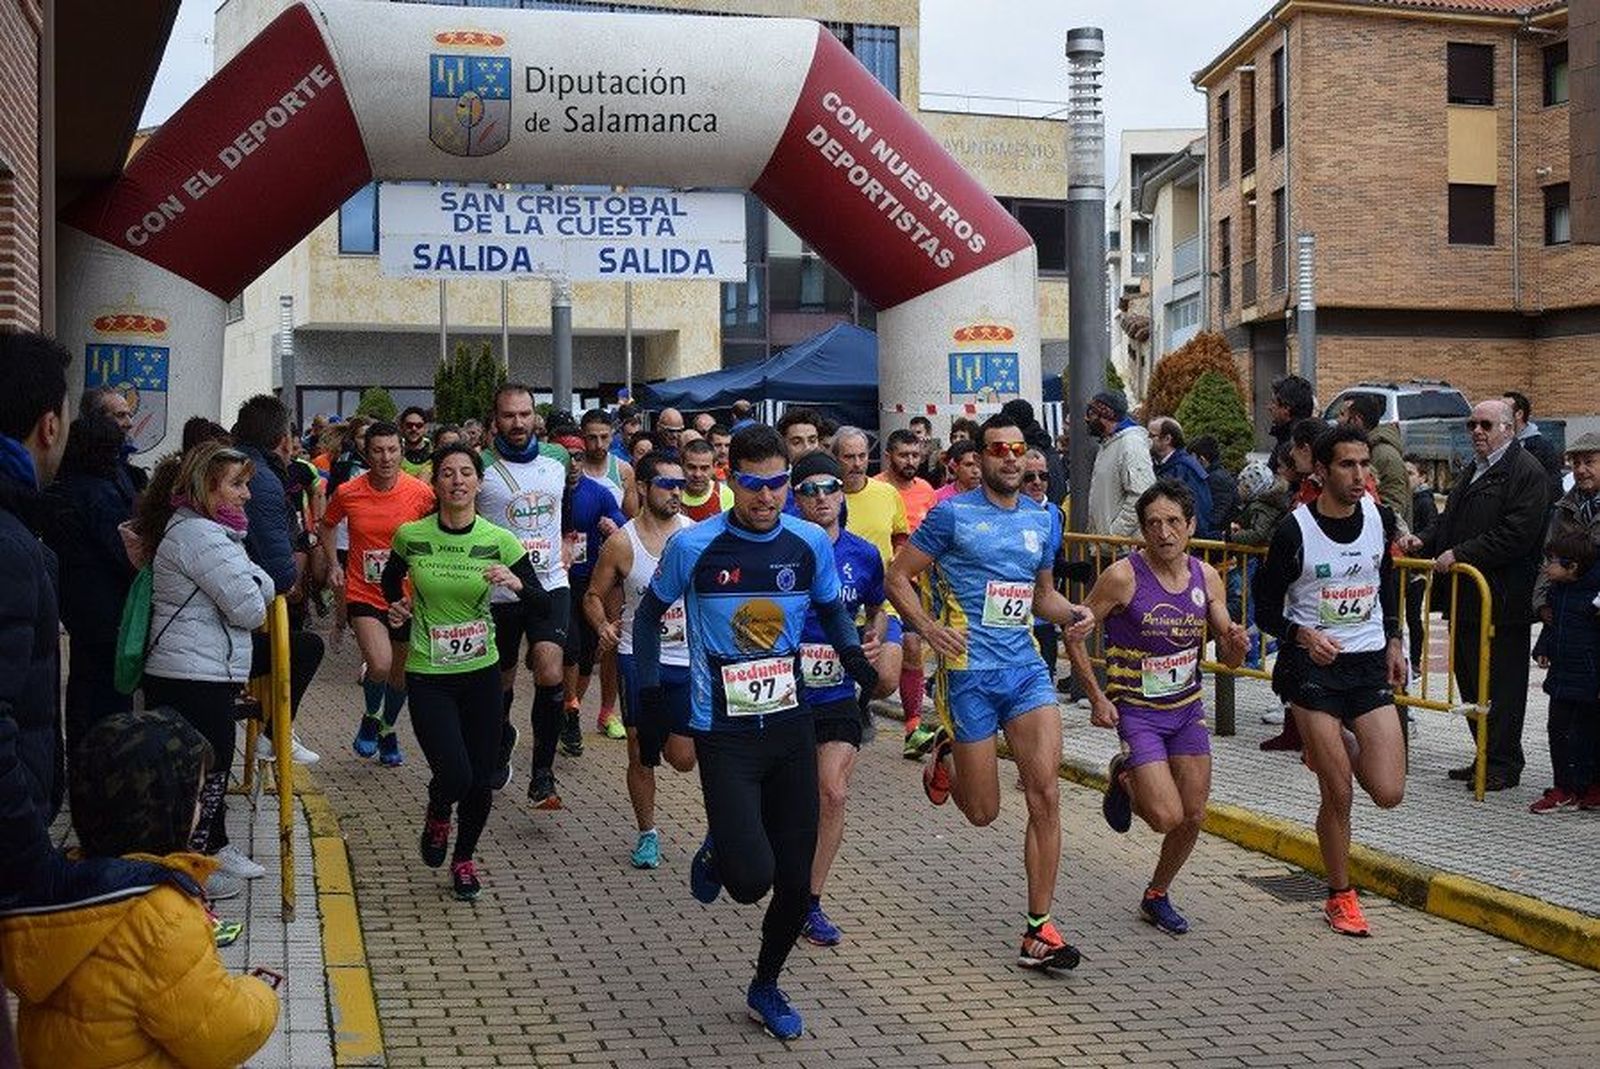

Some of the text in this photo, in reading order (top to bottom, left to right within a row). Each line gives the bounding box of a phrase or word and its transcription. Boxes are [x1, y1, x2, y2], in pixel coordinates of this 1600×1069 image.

[525, 66, 686, 97] Diputación
[525, 105, 718, 133] de Salamanca
[126, 64, 334, 247] CON EL DEPORTE
[821, 91, 986, 254] CON NUESTROS
[440, 192, 688, 217] SAN CRISTOBAL
[806, 124, 955, 269] DEPORTISTAS
[453, 213, 676, 237] DE LA CUESTA
[413, 243, 714, 275] SALIDA SALIDA
[1003, 598, 1023, 617] 62
[1338, 599, 1361, 616] 64
[450, 637, 473, 655] 96
[812, 661, 833, 676] 63
[1168, 668, 1177, 683] 1
[748, 677, 776, 702] 97
